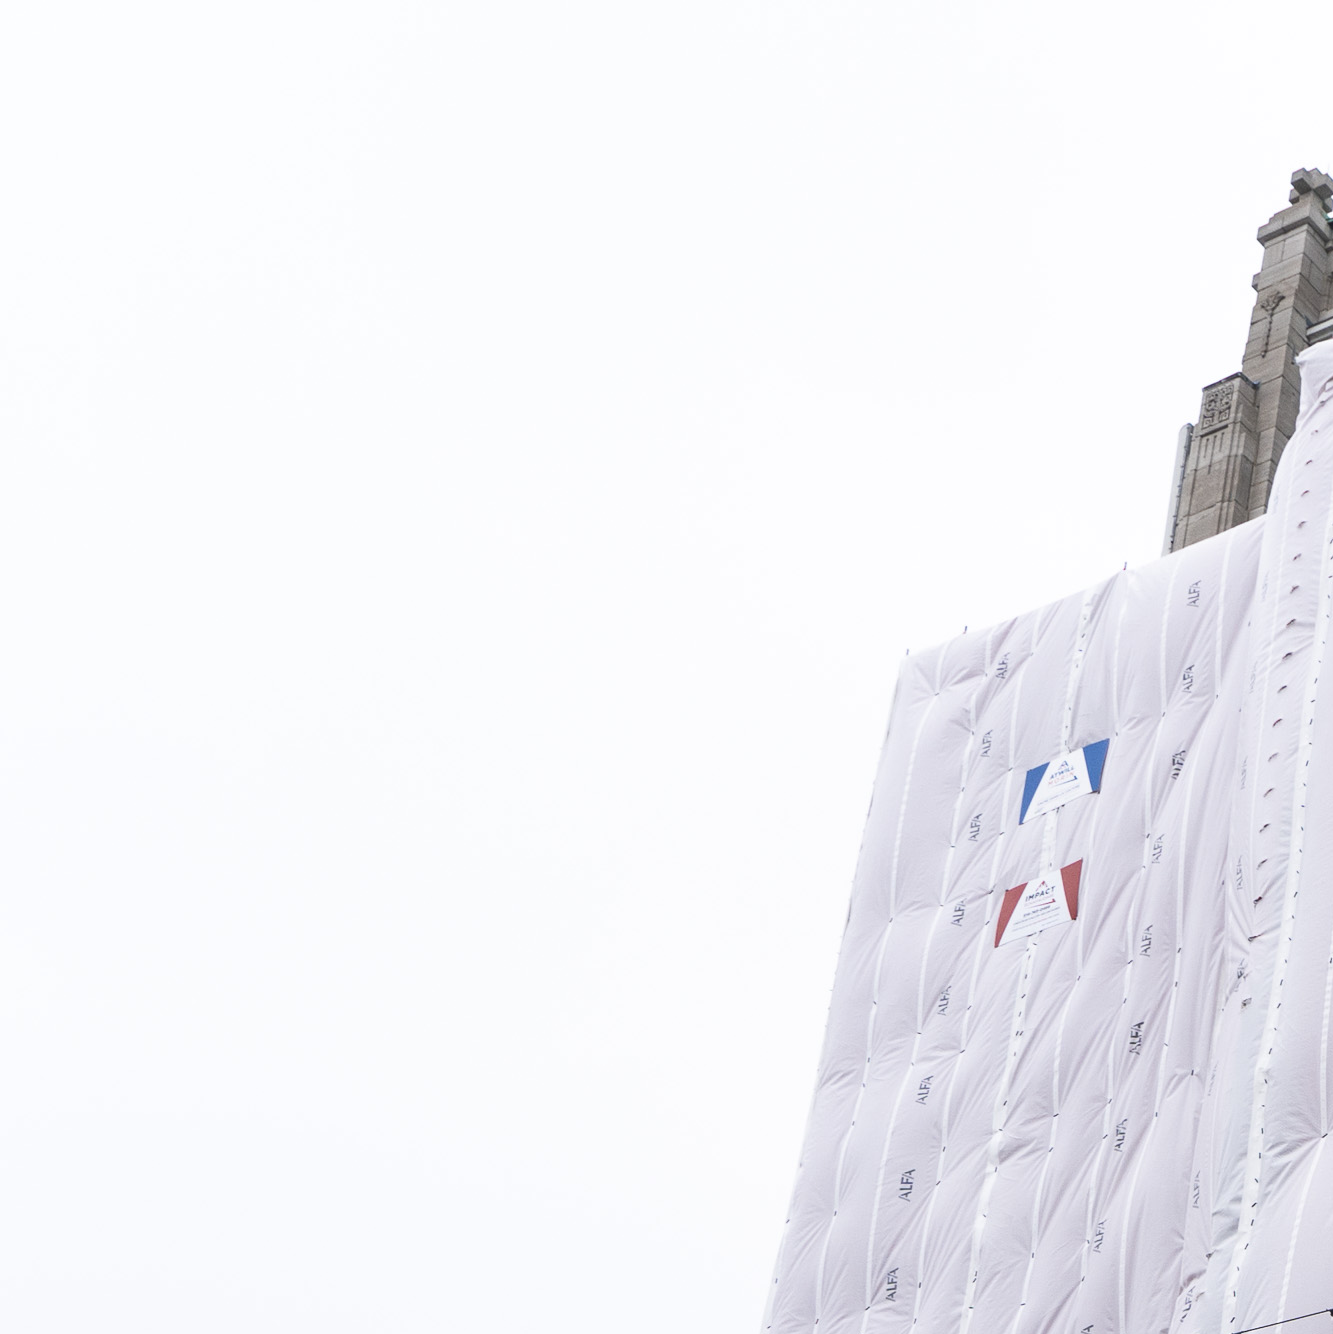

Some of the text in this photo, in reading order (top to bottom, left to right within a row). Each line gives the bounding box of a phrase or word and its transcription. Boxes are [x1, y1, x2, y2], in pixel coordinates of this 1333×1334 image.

[1187, 579, 1201, 608] ALFA
[995, 651, 1010, 680] ALFA
[1181, 664, 1195, 693] ALFA
[981, 729, 993, 757] ALFA
[1171, 748, 1186, 780] ALFA
[968, 812, 983, 841] ALFA
[1151, 833, 1165, 864] ALFA
[1025, 885, 1055, 902] IMPACT
[951, 897, 967, 927] ALFA
[1139, 924, 1154, 957] ALFA
[938, 986, 952, 1016] ALFA
[1129, 1020, 1145, 1056] ALFA
[916, 1074, 934, 1105] ALFA
[1114, 1117, 1128, 1153] ALFA
[898, 1168, 916, 1202] ALFA
[1092, 1219, 1107, 1254] ALFA
[886, 1267, 899, 1302] ALFA
